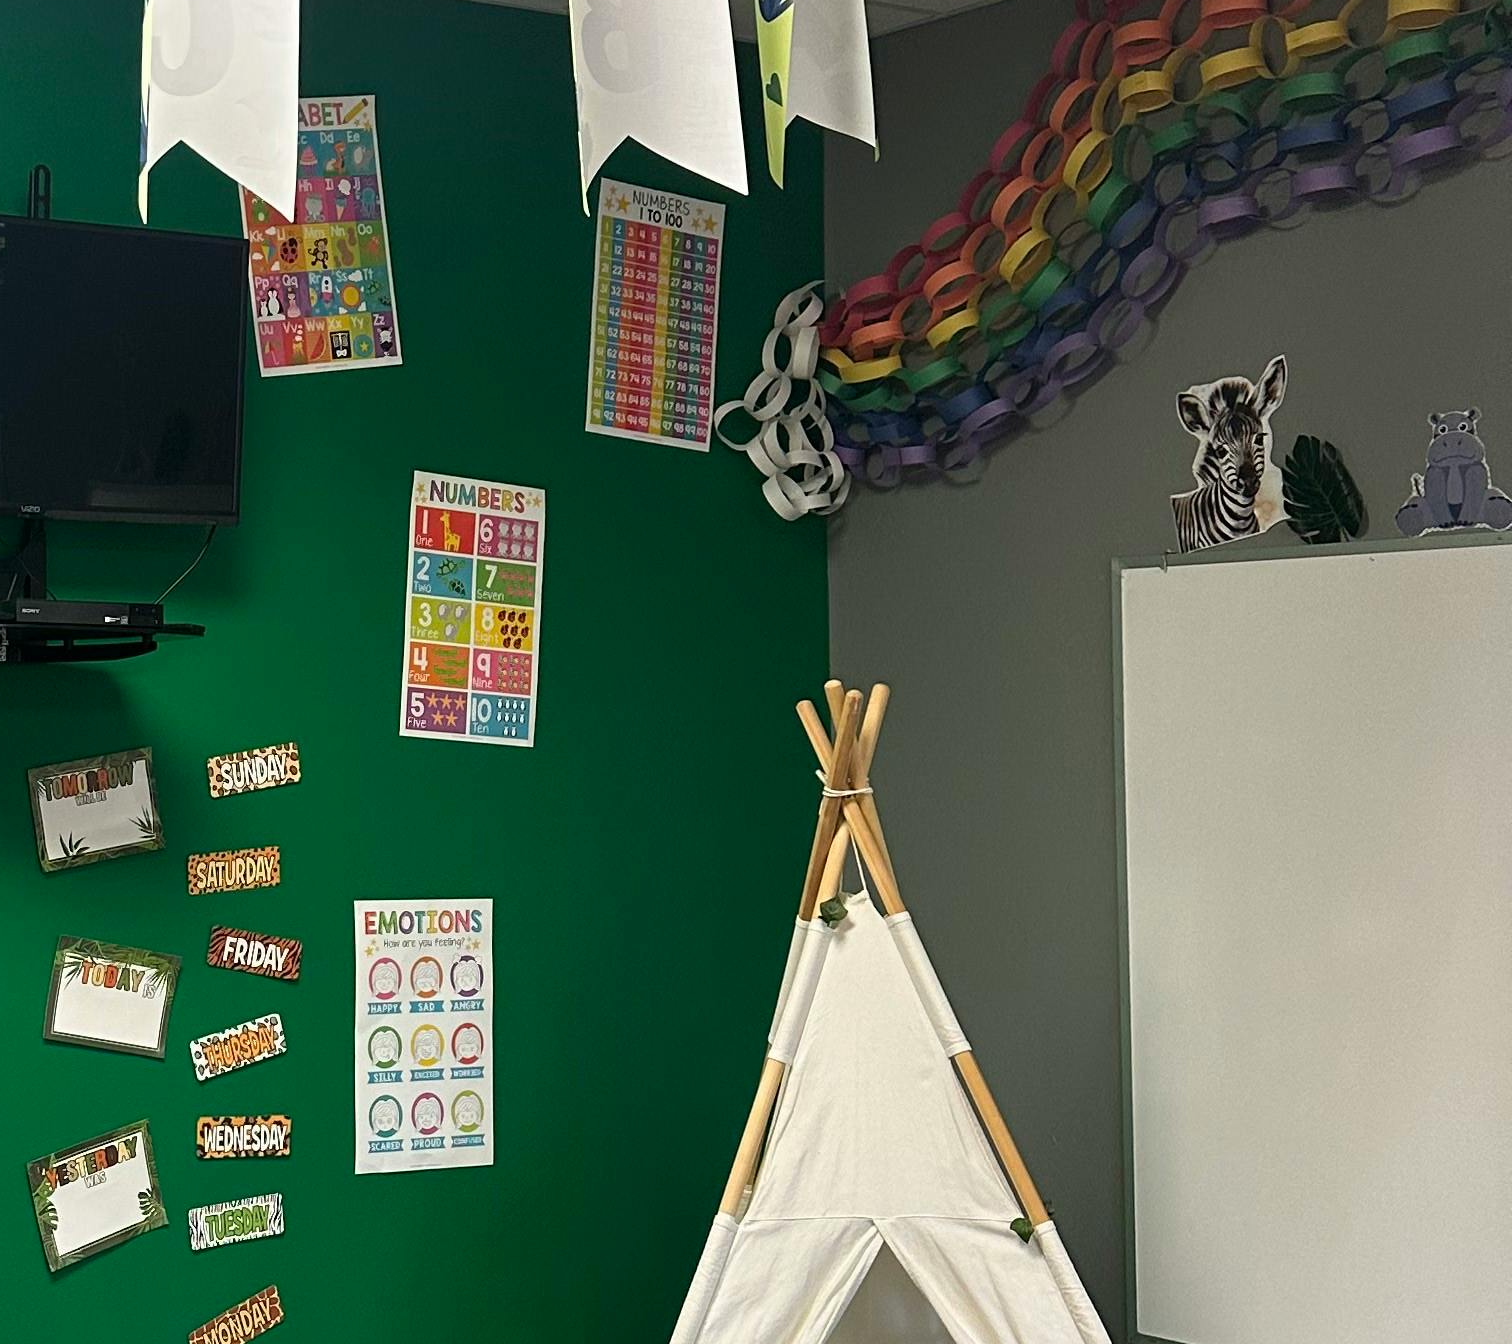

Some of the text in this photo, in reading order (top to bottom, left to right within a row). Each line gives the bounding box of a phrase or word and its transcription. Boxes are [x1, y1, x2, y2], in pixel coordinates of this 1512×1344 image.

[319, 131, 360, 144] Dd Ee
[633, 190, 690, 216] NUMBERS
[648, 209, 662, 223] TO
[665, 213, 683, 228] 100
[254, 276, 270, 290] Pp
[429, 479, 525, 514] NUMBERS
[417, 557, 498, 588] 2 7
[418, 602, 432, 627] 3
[413, 647, 428, 671] 4
[410, 692, 492, 722] 5 10
[41, 762, 134, 802] TOMORROW
[220, 752, 287, 790] SUNDAY
[196, 855, 275, 889] SATURDAY
[364, 909, 482, 935] EMOTIONS
[223, 936, 290, 972] FRIDAY
[80, 959, 156, 999] TODAY IS
[370, 1002, 435, 1014] HAPPY SAD
[203, 1023, 277, 1072] THURSDAY
[374, 1072, 397, 1083] SILLY
[204, 1124, 287, 1152] WEDNESDAY
[414, 1138, 442, 1150] PROUD
[44, 1136, 138, 1189] YESTERDAY
[84, 1171, 107, 1188] WAS
[205, 1204, 271, 1241] TUESDAY
